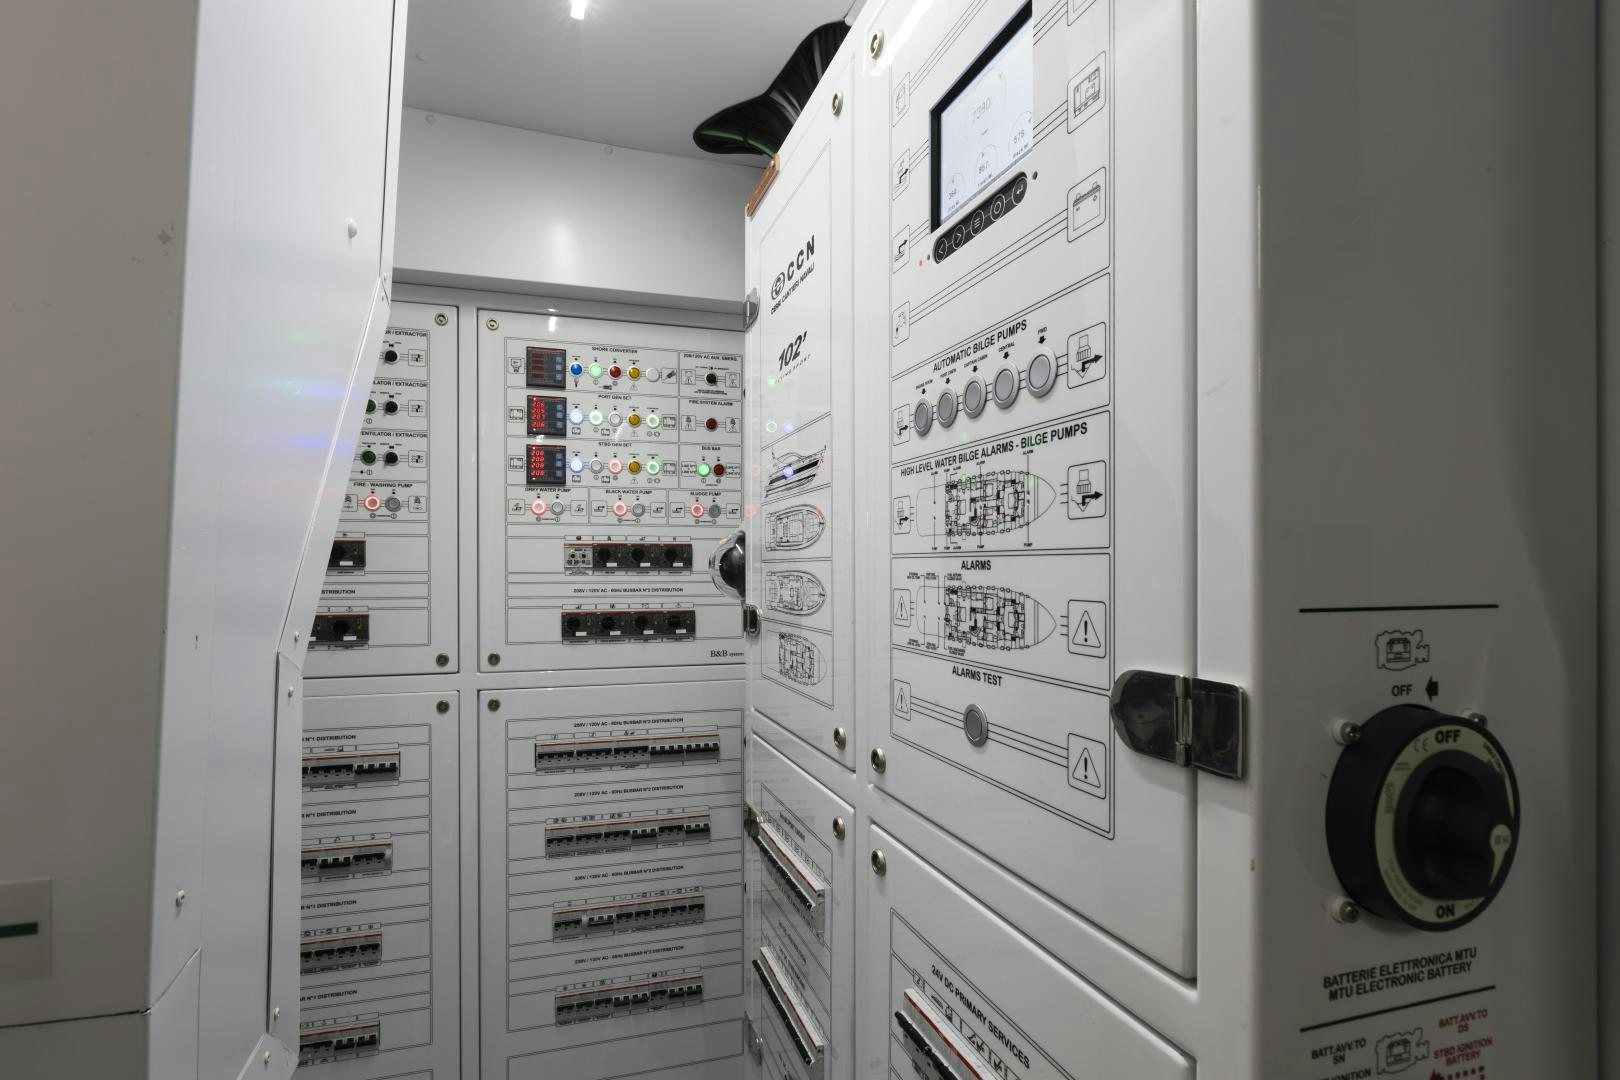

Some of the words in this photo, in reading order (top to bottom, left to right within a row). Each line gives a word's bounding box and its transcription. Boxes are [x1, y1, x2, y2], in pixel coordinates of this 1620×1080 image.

[1037, 326, 1048, 336] FWD
[932, 345, 972, 374] AUTOMATIC
[972, 334, 996, 355] BILGE
[996, 319, 1028, 343] PUMPS
[998, 341, 1015, 353] CENTRAL
[900, 466, 915, 478] HIGH
[915, 461, 934, 475] LEVEL
[934, 455, 957, 471] WATER
[958, 449, 980, 464] BILGE
[981, 440, 1015, 459] ALARMS
[1021, 431, 1048, 449] BILGE
[1050, 421, 1088, 443] PUMPS
[960, 559, 992, 571] ALARMS
[710, 649, 728, 657] B&B
[951, 665, 981, 683] ALARMS
[981, 672, 1003, 688] TEST
[1391, 684, 1413, 697] OFF
[1434, 728, 1462, 744] OFF
[316, 809, 357, 817] DISTRIBUTION
[316, 900, 357, 908] DISTRIBUTION
[1435, 903, 1456, 920] ON
[1323, 966, 1378, 989] BATTERIE
[1379, 951, 1453, 978] ELETTRONICA
[1453, 946, 1478, 963] MTU
[1328, 985, 1354, 1003] MTU
[1355, 969, 1426, 996] ELECTRONIC
[1426, 960, 1474, 982] BATTERY
[317, 988, 358, 1000] DISTRIBUTION
[931, 963, 944, 983] 24V
[943, 976, 955, 994] DC
[954, 986, 988, 1027] PRIMARY
[987, 1019, 1031, 1071] SERVICES
[1457, 1023, 1470, 1035] DS
[1433, 1045, 1457, 1062] STBD
[1456, 1037, 1494, 1055] IGNITION
[1332, 1054, 1347, 1066] SN
[1445, 1049, 1482, 1068] BATTERY
